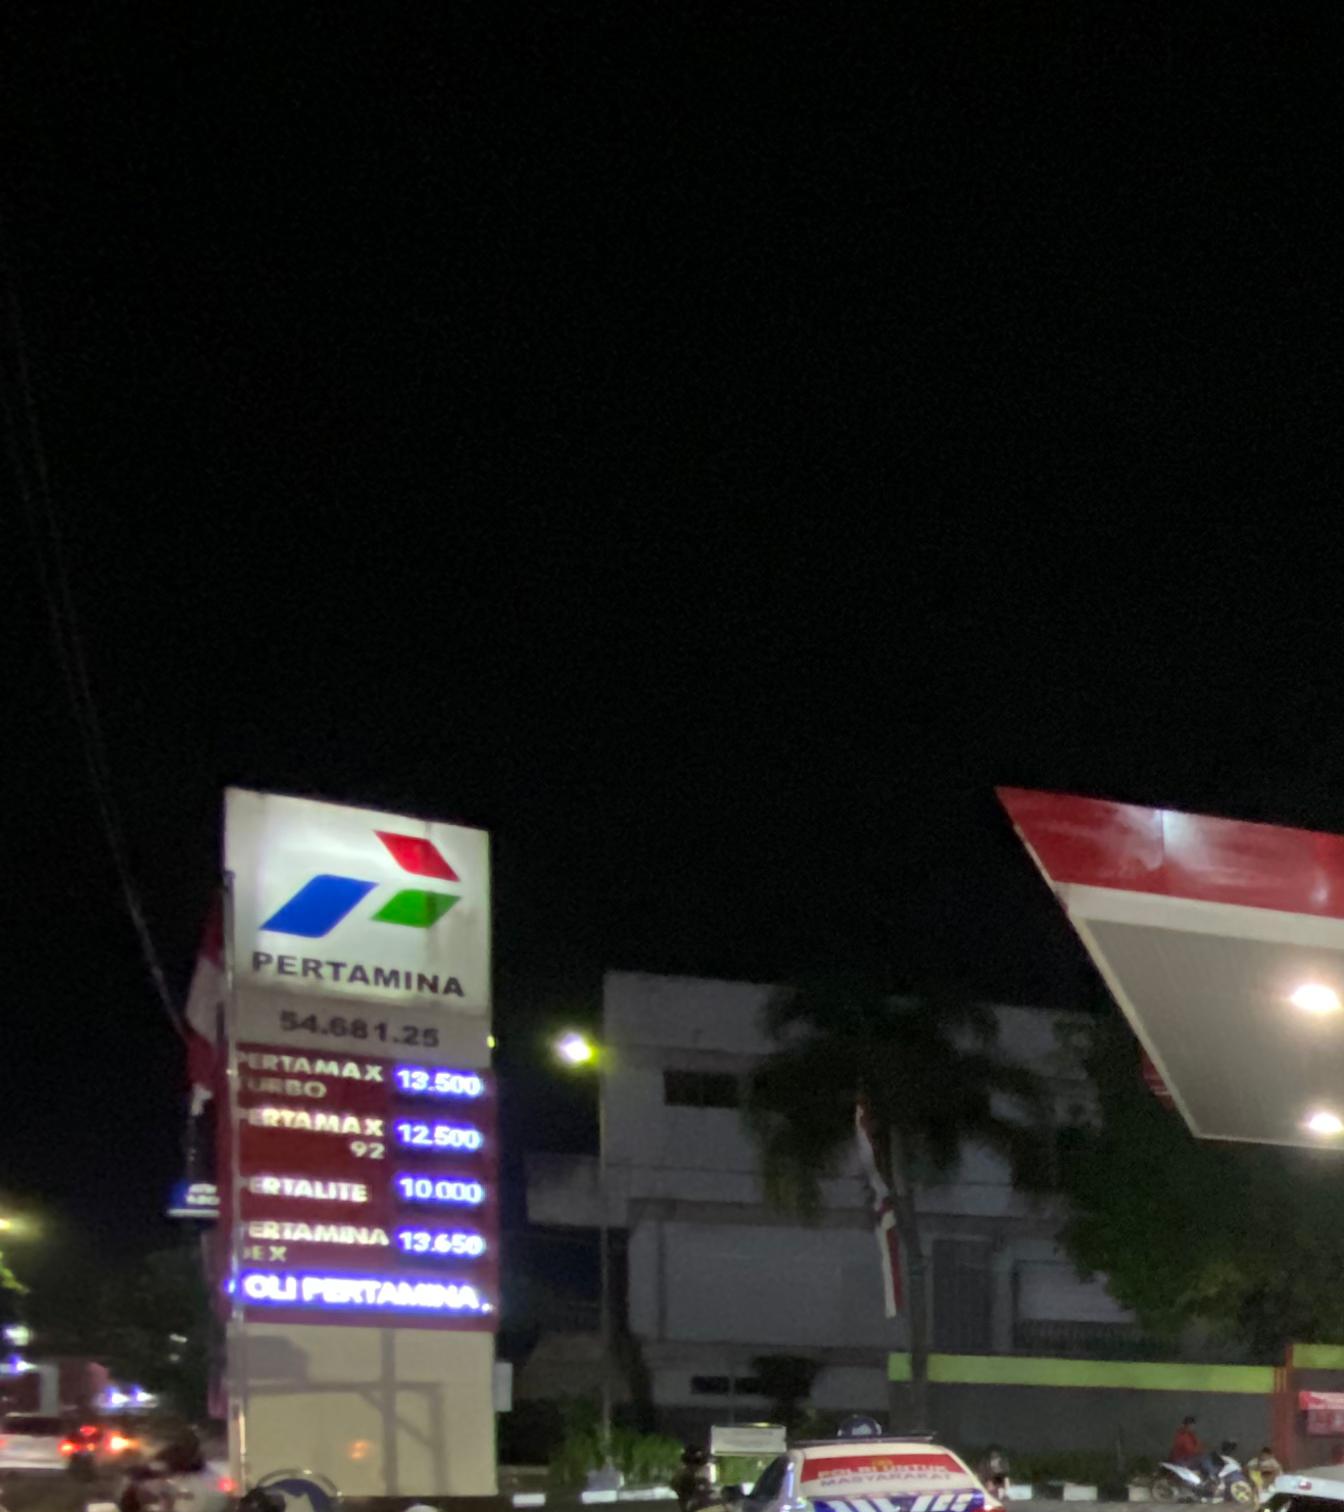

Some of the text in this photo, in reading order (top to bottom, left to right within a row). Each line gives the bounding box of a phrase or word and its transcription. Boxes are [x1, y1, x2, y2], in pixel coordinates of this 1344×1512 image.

[252, 951, 465, 998] PERTAMINA
[279, 1010, 440, 1048] 54.681.25
[240, 1075, 328, 1098] URBO
[397, 1069, 484, 1096] 13.500
[350, 1141, 386, 1160] 92
[397, 1123, 484, 1151] 12.500
[399, 1177, 484, 1205] 10.000
[241, 1220, 486, 1257] ERTAMINA 13.650
[243, 1273, 297, 1301] OLI
